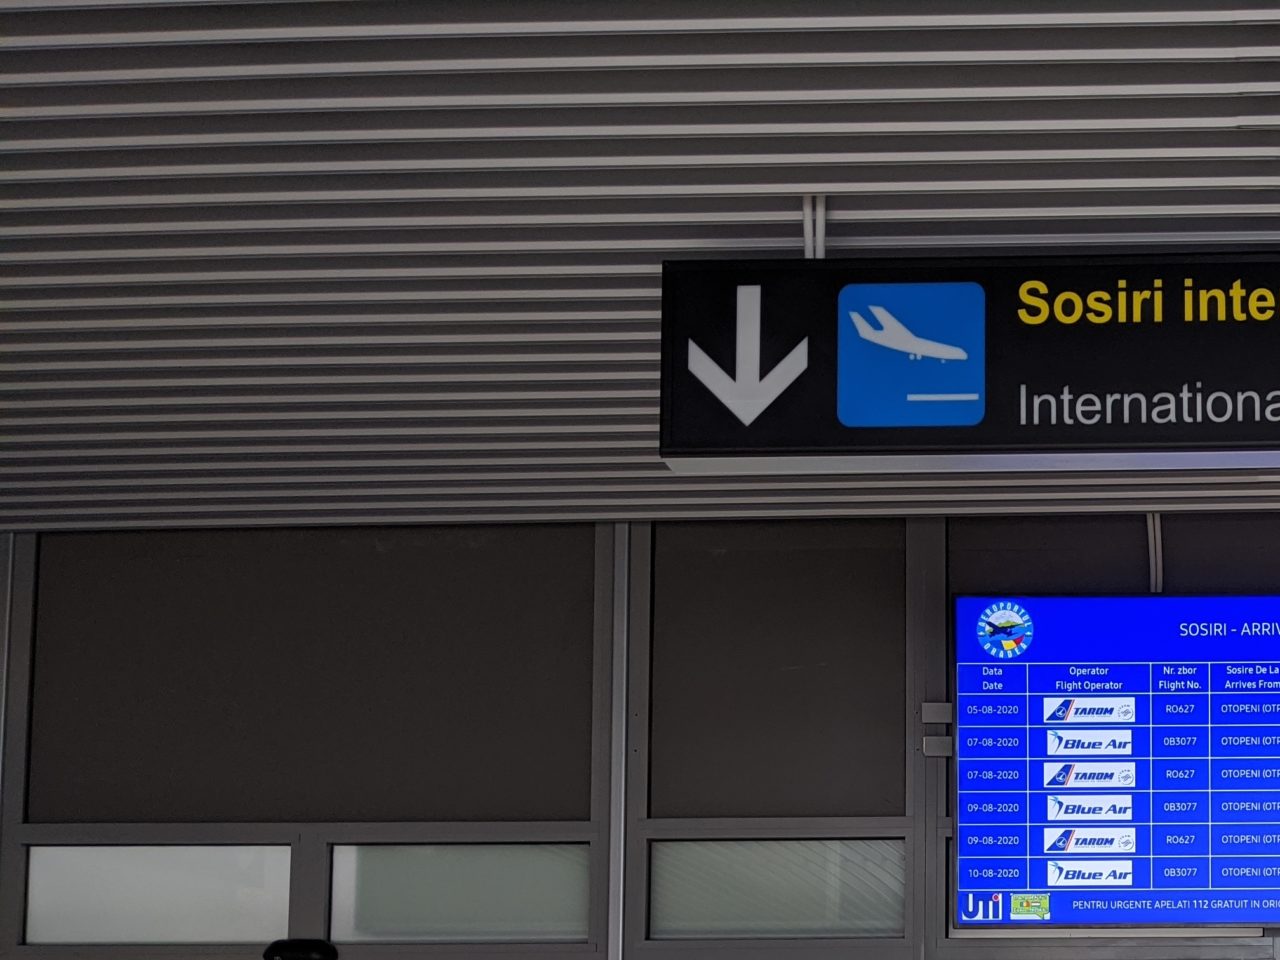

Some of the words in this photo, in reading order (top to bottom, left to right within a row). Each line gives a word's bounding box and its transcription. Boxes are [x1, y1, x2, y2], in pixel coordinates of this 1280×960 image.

[1018, 279, 1162, 324] Sosiri
[978, 602, 1032, 628] AEROPORTUL
[1180, 623, 1226, 636] SOSIRI
[984, 642, 1028, 658] ORADEA
[983, 667, 1002, 675] Data
[1070, 667, 1109, 677] Operator
[1164, 666, 1175, 674] Nr.
[1178, 666, 1197, 674] zbor
[1227, 666, 1253, 674] Sosire
[1256, 665, 1267, 674] De
[1269, 666, 1279, 674] La
[983, 681, 1003, 689] Date
[1056, 681, 1081, 691] Flight
[1084, 681, 1122, 691] Operator
[1159, 681, 1184, 690] Flight
[1225, 680, 1256, 688] Arrives
[1259, 680, 1280, 688] From
[967, 706, 1018, 714] 05-08-2020
[1074, 708, 1114, 716] TAROM
[1166, 705, 1194, 713] RO627
[1221, 704, 1260, 712] OTOPENI
[967, 738, 1019, 746] 07-08-2020
[1063, 739, 1102, 749] Blue
[1106, 739, 1131, 749] Air
[1221, 737, 1260, 745] OTOPENI
[968, 771, 1019, 779] 07-08-2020
[1166, 770, 1194, 778] RO627
[1222, 770, 1260, 778] OTOPENI
[968, 804, 1019, 812] 09-08-2020
[1063, 804, 1102, 815] Blue
[1106, 804, 1131, 815] Air
[1222, 802, 1260, 810] OTOPENI
[1074, 838, 1114, 846] TAROM
[1222, 835, 1260, 843] OTOPENI
[969, 869, 1019, 877] 10-08-2020
[1063, 870, 1102, 880] Blue
[1106, 870, 1131, 880] Air
[1222, 868, 1260, 876] OTOPENI
[1073, 901, 1108, 909] PENTRU
[1111, 901, 1152, 909] URGENTE
[1154, 900, 1190, 908] APELATI
[1193, 900, 1208, 908] 112
[1211, 900, 1248, 908] GRATUIT
[1251, 900, 1259, 908] IN
